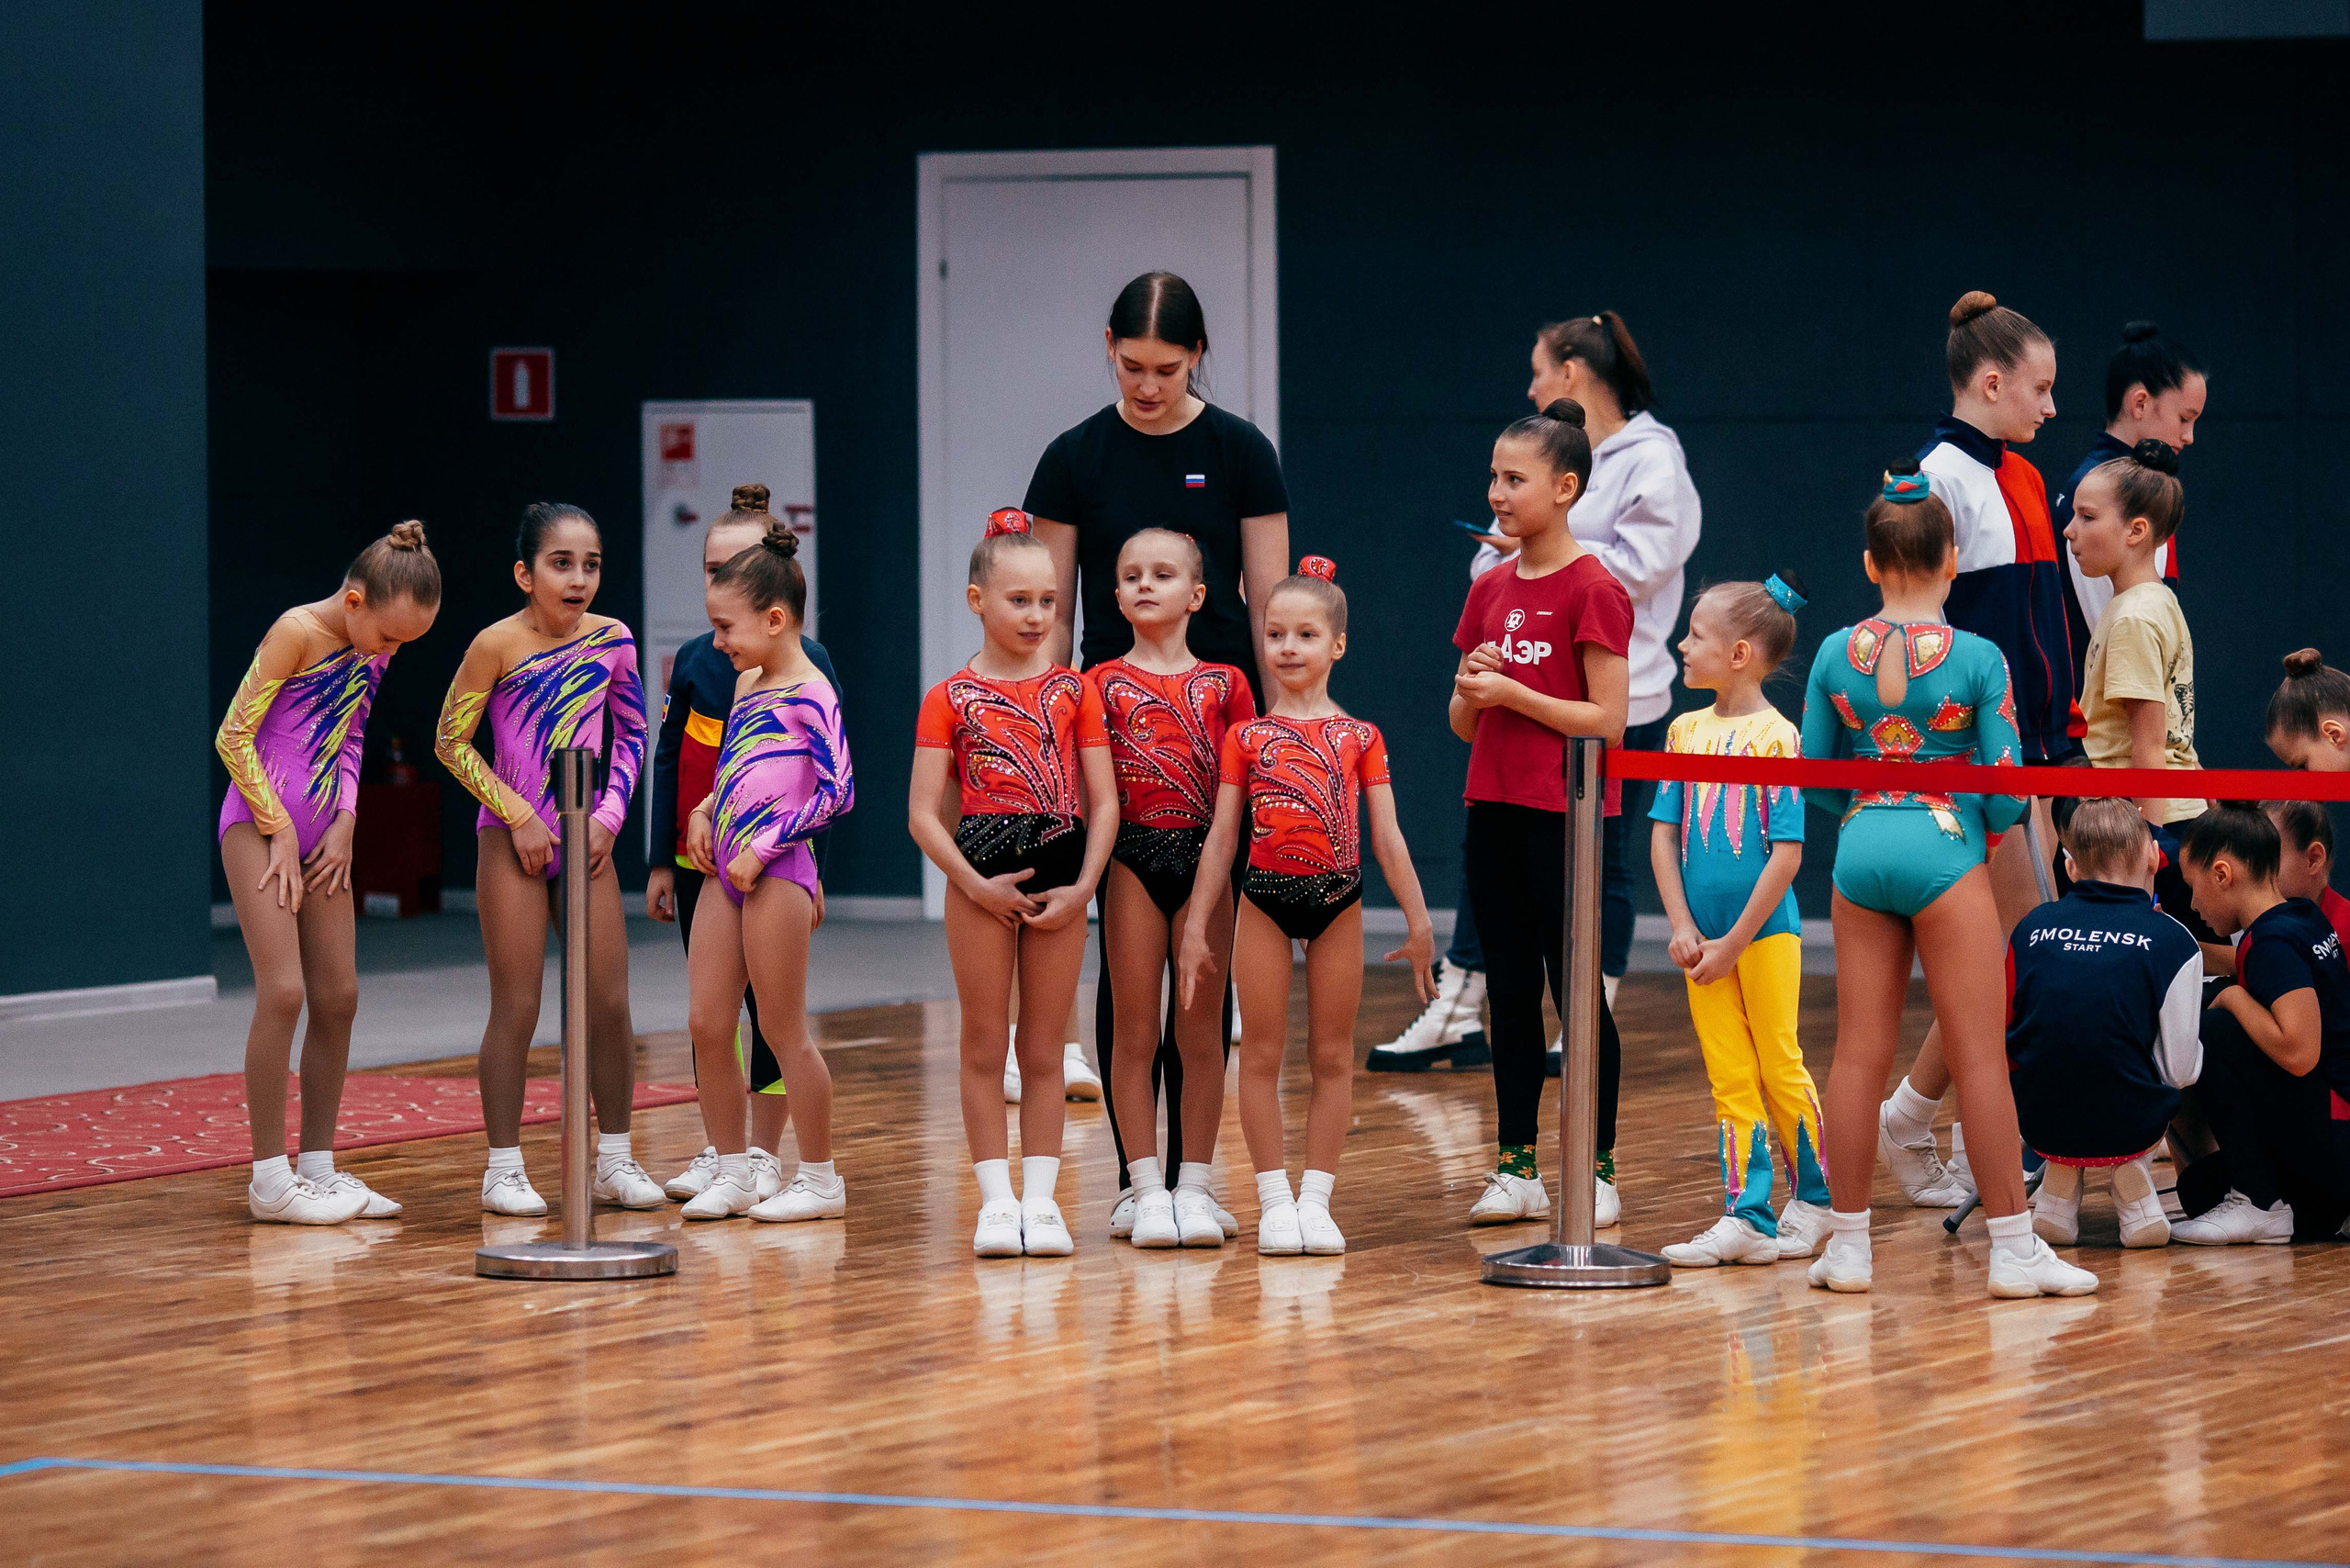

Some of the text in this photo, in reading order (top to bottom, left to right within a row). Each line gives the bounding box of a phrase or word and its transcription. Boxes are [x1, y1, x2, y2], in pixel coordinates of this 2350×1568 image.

[1487, 633, 1552, 666] АЭР
[2029, 927, 2153, 951] SMOLENSK
[2063, 942, 2102, 952] START
